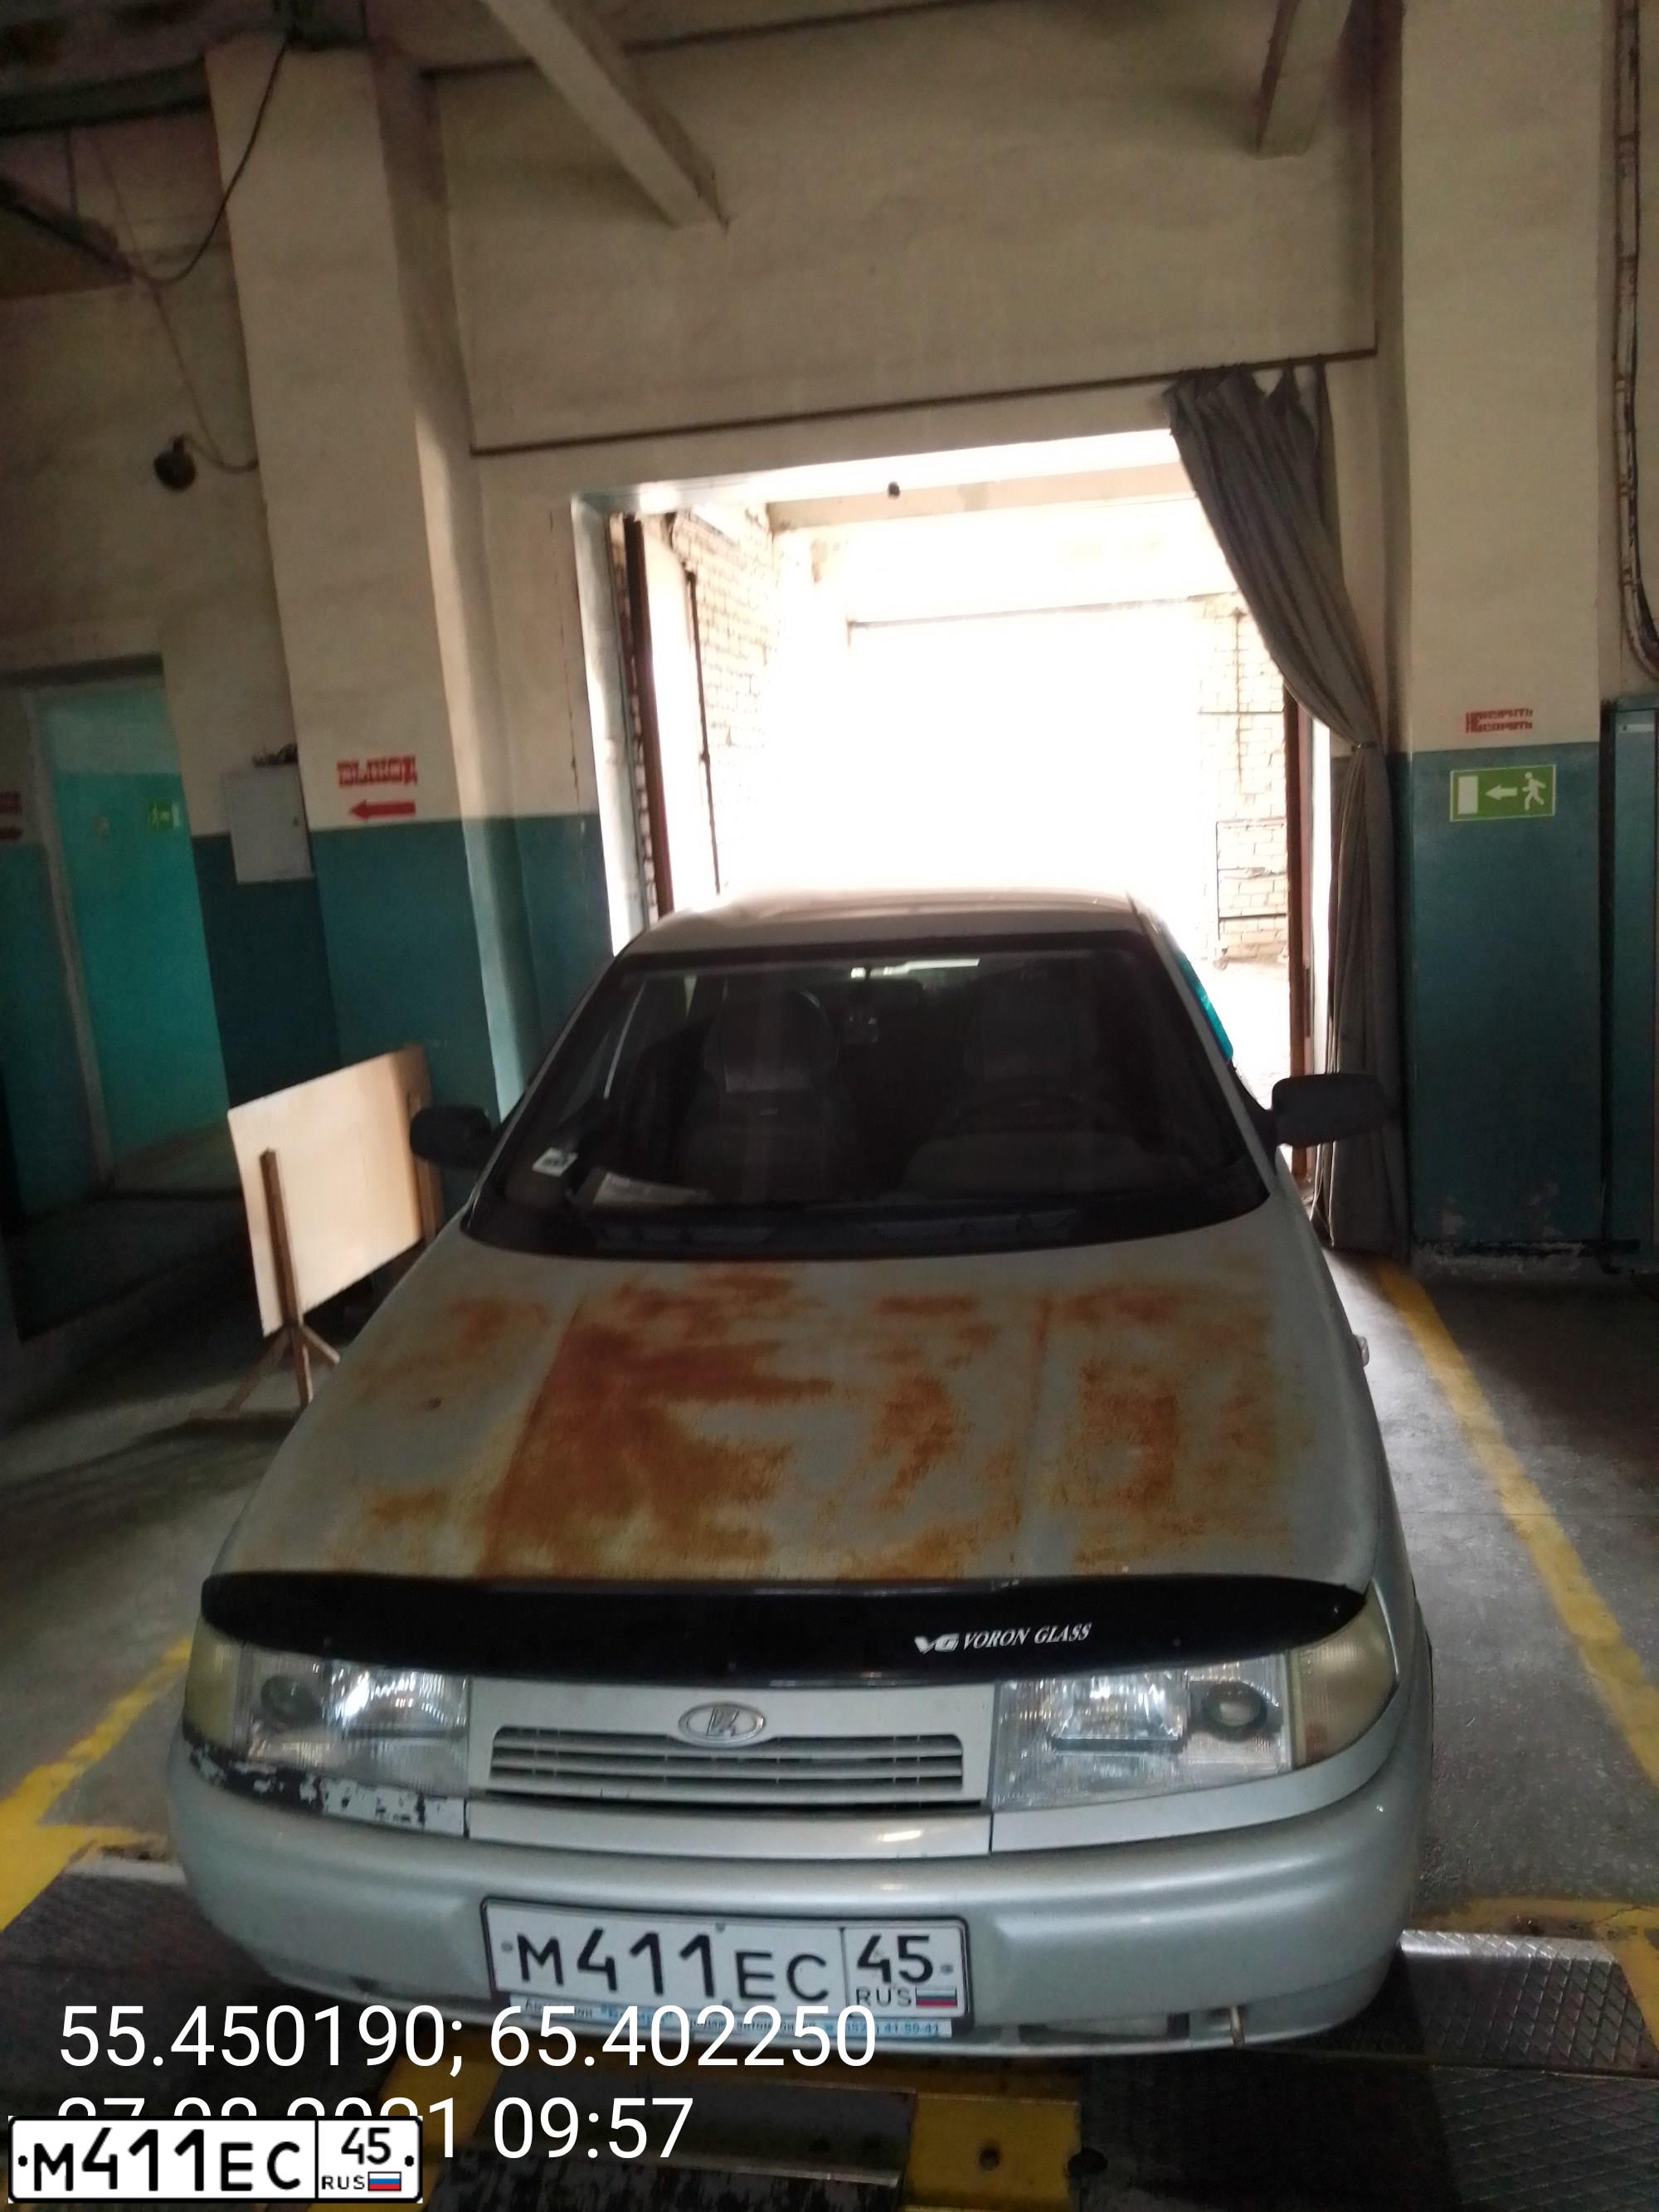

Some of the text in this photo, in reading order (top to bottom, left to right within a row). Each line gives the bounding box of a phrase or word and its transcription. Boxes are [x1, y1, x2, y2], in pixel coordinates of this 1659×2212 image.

[963, 1627, 1031, 1650] VORON
[1034, 1622, 1092, 1644] GLASS
[856, 1934, 934, 1984] 45
[855, 1988, 912, 2008] RUS
